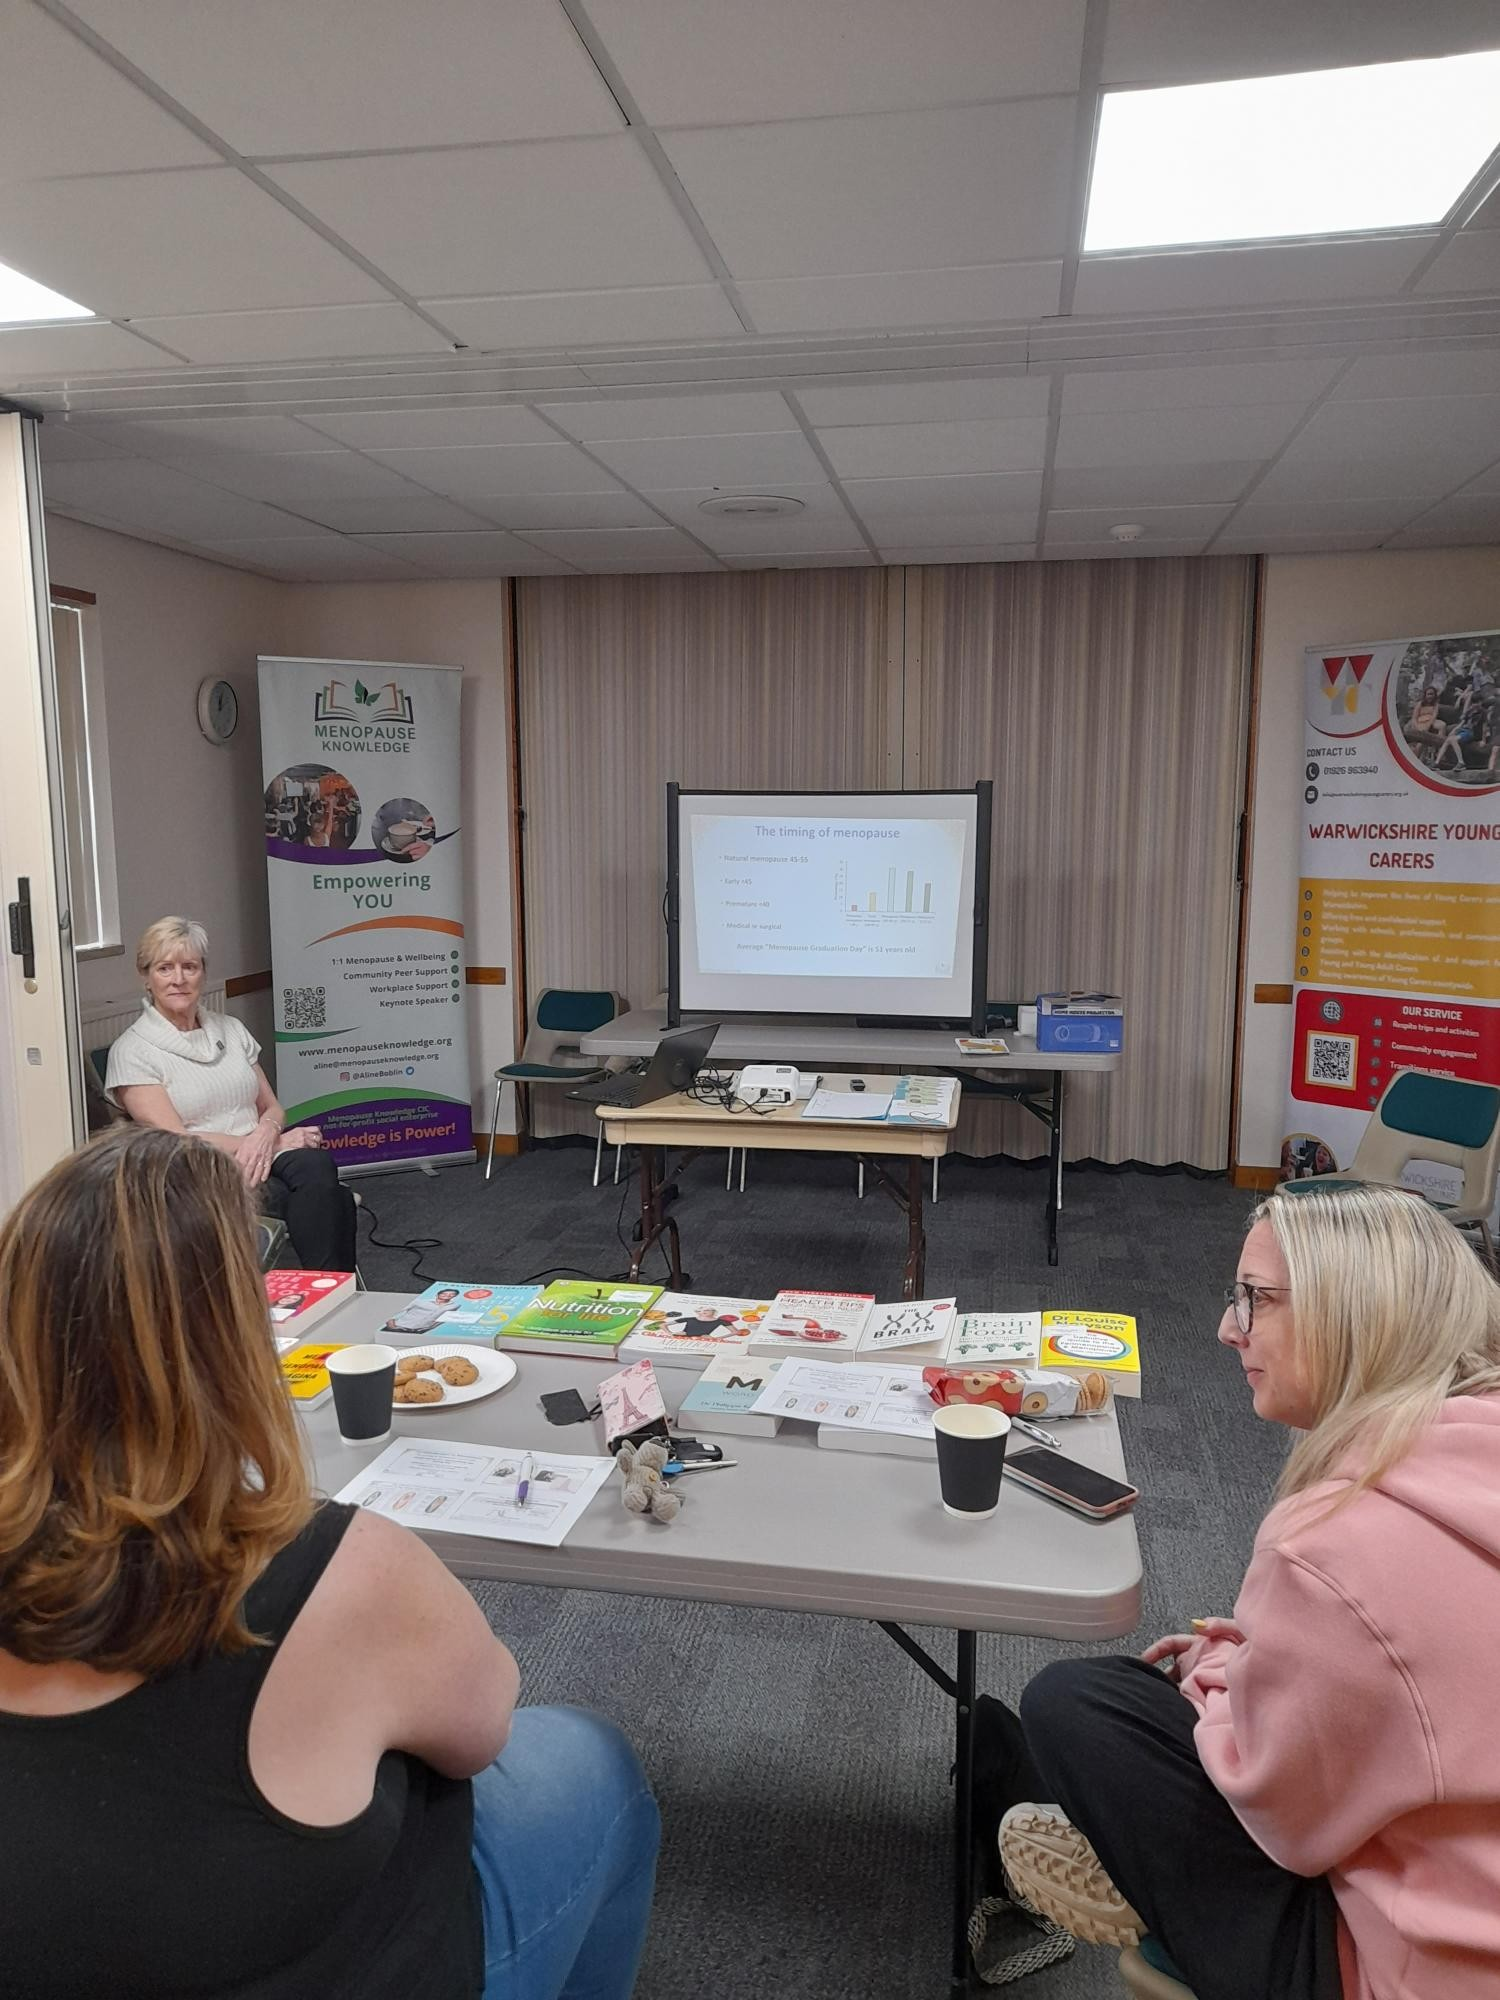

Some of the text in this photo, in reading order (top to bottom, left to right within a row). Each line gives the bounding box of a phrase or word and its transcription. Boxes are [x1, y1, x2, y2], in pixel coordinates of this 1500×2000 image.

[315, 725, 416, 740] MENOPAUSE
[322, 740, 411, 753] KNOWLEDGE
[1306, 747, 1357, 758] CONTACT US
[755, 825, 900, 841] The timing of menopause
[1308, 823, 1500, 841] WARWICKSHIRE YOUNG
[724, 855, 748, 863] Natural
[750, 856, 788, 865] menopause
[1370, 852, 1434, 869] CARERS
[313, 872, 431, 893] Empowering
[724, 878, 739, 887] Early
[353, 894, 393, 909] YOU
[726, 922, 750, 930] Medical
[759, 923, 782, 932] surgical
[737, 943, 763, 953] Average
[810, 944, 848, 953] Graduation
[884, 947, 903, 955] years
[346, 956, 394, 968] Menopause
[405, 953, 446, 962] Wellbeing
[343, 968, 448, 981] Community Peer Support
[369, 982, 448, 994] Workplace Support
[380, 996, 448, 1009] Keynote Speaker
[1402, 1005, 1462, 1020] OUR SERVICE
[1392, 1020, 1479, 1038] Respite trips and activities
[298, 1037, 453, 1057] www.menopauseknowledge.org
[1391, 1042, 1477, 1060] Community engagement
[313, 1053, 440, 1071] aline@menopauseknowledge.org
[320, 1122, 456, 1150] owledge is Power!
[527, 1298, 646, 1317] Nutrition
[779, 1298, 835, 1306] HEALTH
[840, 1300, 866, 1310] TIPS
[541, 1308, 612, 1322] for life
[1076, 1315, 1128, 1326] Louise
[962, 1318, 1032, 1328] Brain
[873, 1325, 935, 1339] BRAIN
[961, 1326, 1023, 1337] Food
[726, 1376, 764, 1391] M
